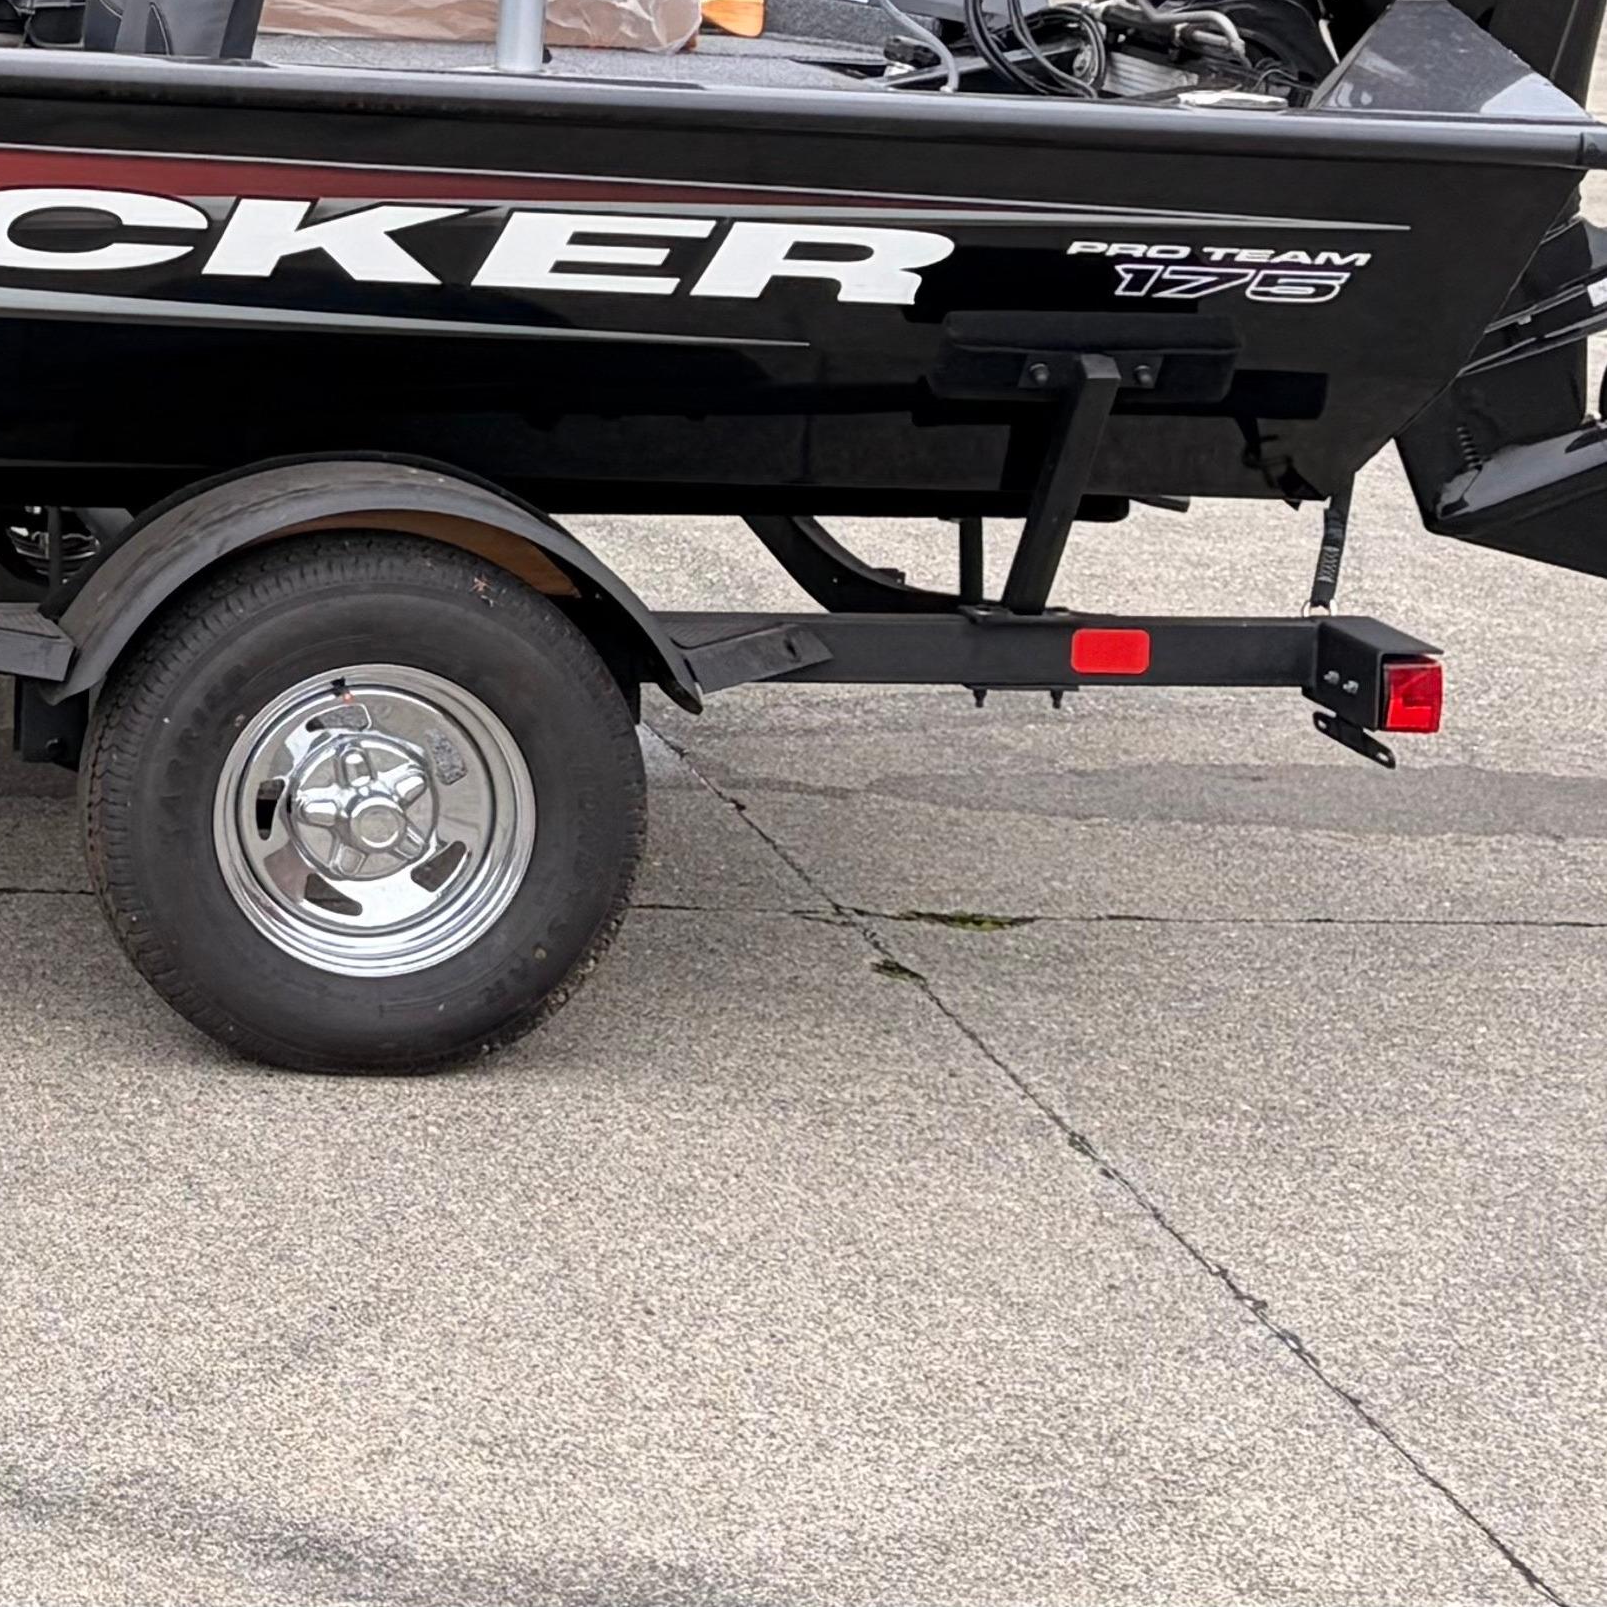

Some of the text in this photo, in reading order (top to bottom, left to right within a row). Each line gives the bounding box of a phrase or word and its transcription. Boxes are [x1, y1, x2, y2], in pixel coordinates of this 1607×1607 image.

[1066, 240, 1372, 267] PRO TEAM
[1113, 263, 1351, 304] 175
